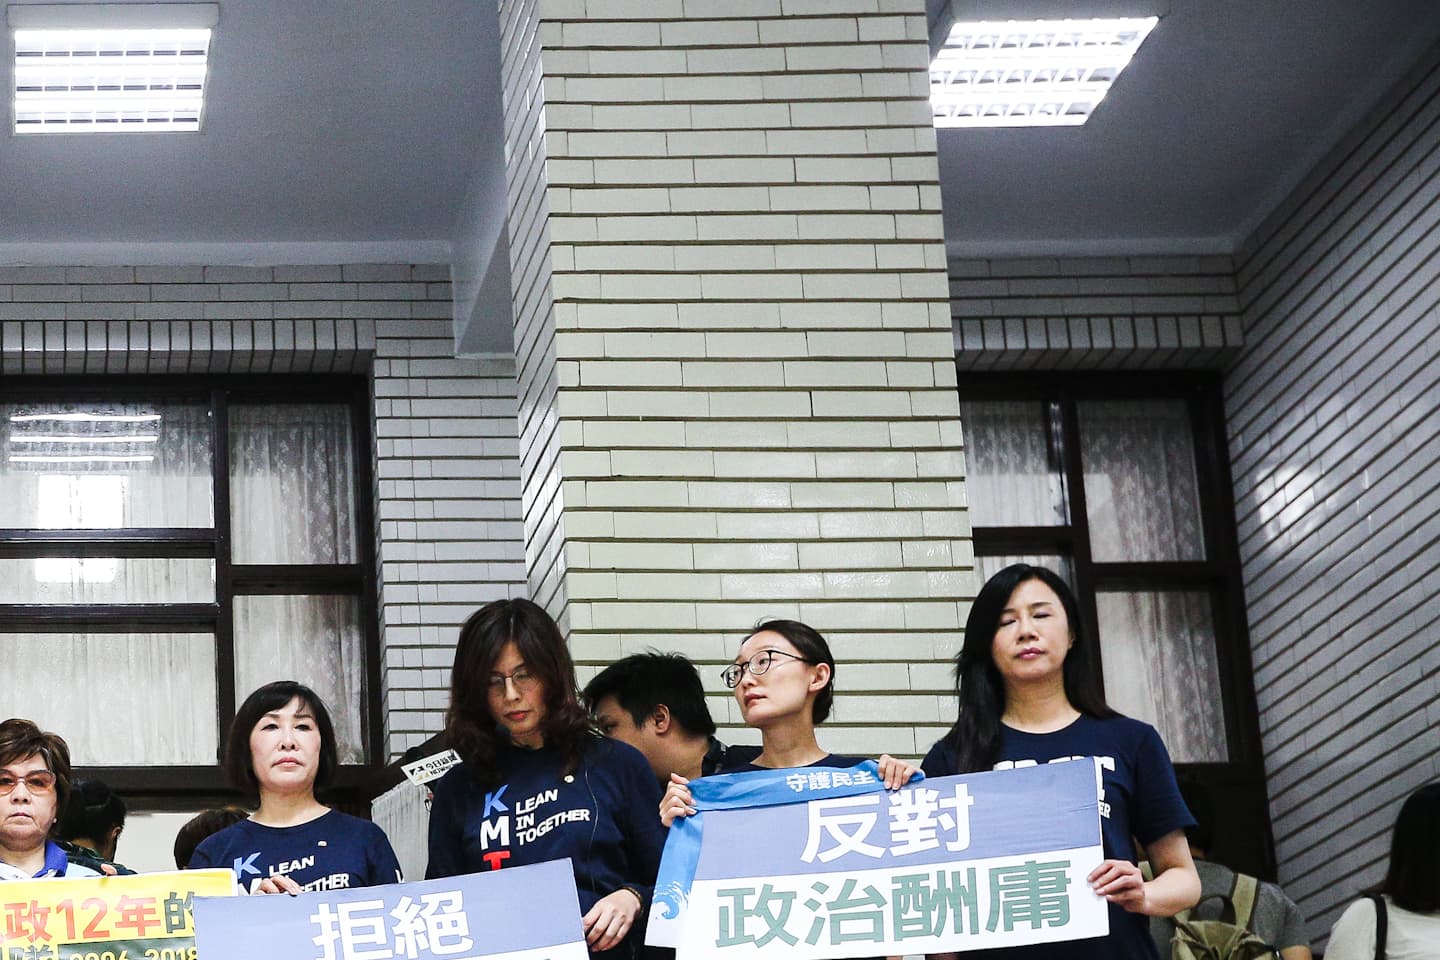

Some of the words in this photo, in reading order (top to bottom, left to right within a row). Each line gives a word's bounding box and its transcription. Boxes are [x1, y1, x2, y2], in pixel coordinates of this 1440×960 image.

[786, 771, 875, 792] 守護民主
[516, 789, 558, 815] LEAN
[516, 813, 535, 831] IN
[516, 809, 590, 845] TOGETHER
[800, 783, 973, 864] 反對
[269, 856, 315, 877] LEAN
[715, 860, 1071, 949] 政治酬庸
